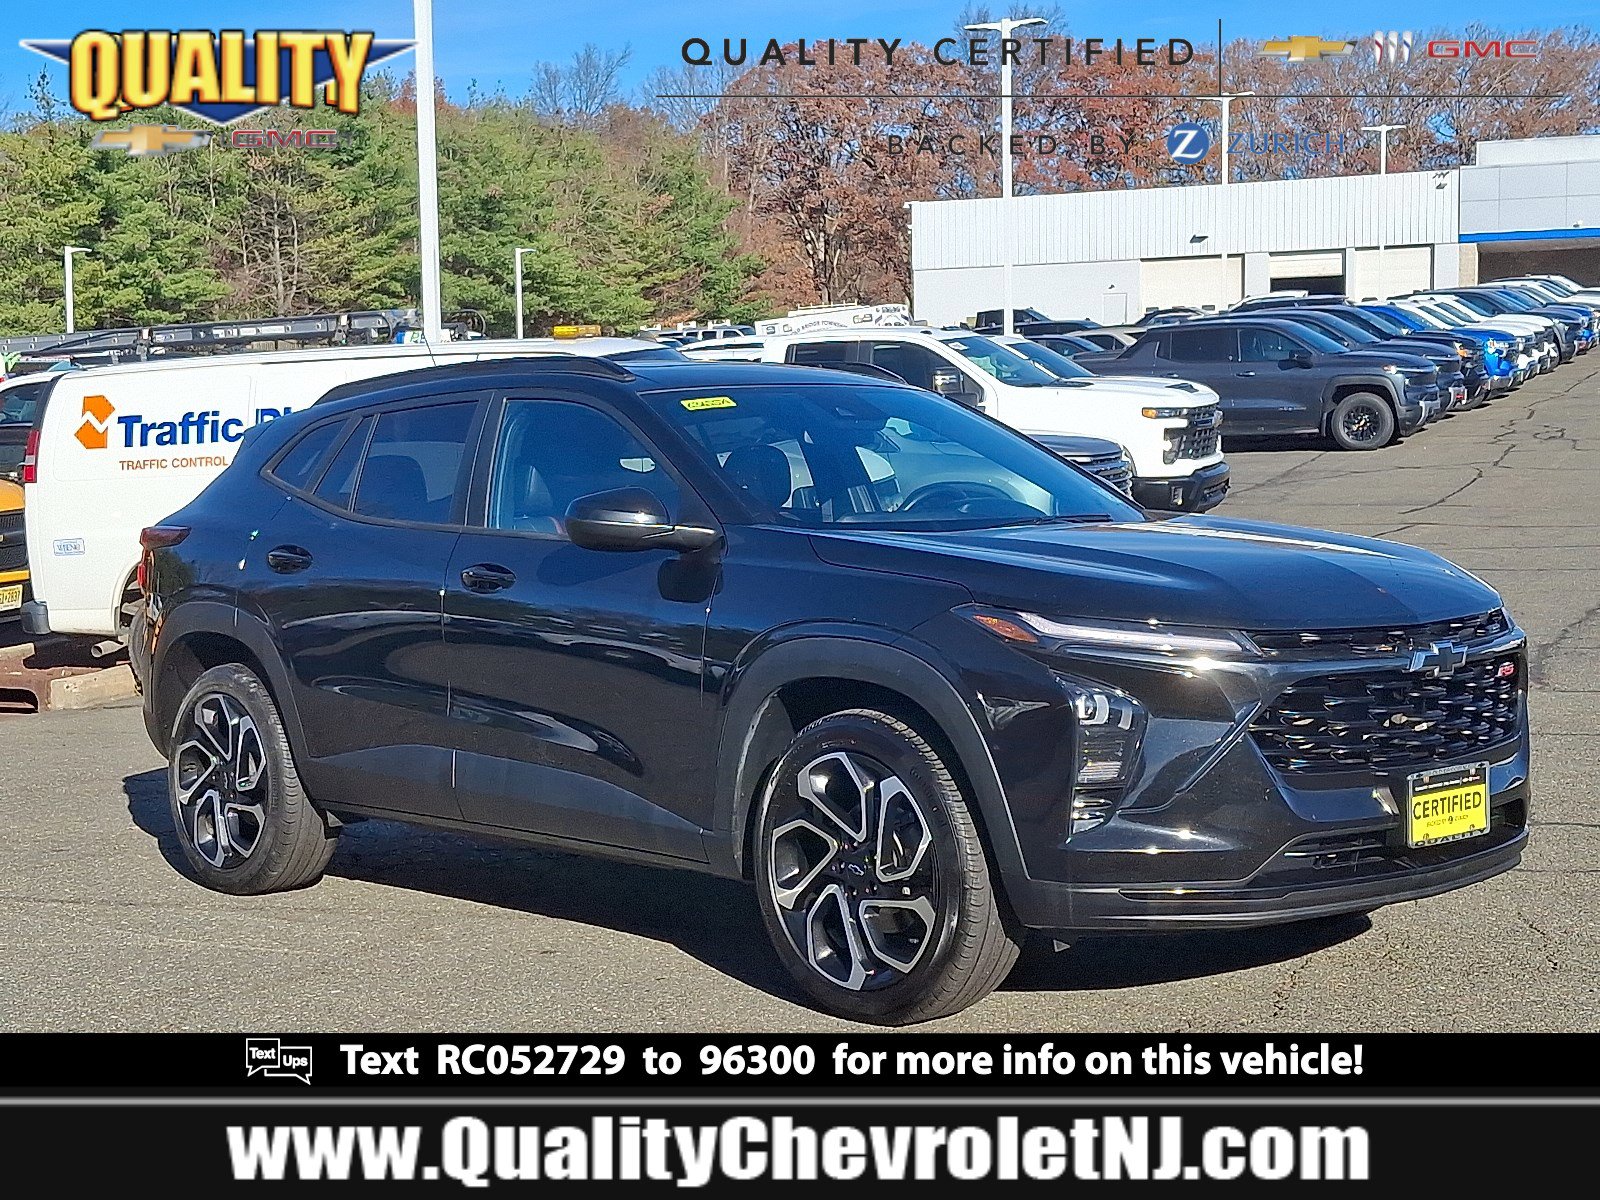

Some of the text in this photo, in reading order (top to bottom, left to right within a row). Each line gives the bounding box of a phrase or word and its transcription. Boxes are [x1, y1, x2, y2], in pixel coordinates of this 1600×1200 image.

[117, 410, 244, 448] Traffic
[119, 455, 229, 471] TRAFFIC CONTROL
[1413, 791, 1482, 820] CERTIFIED
